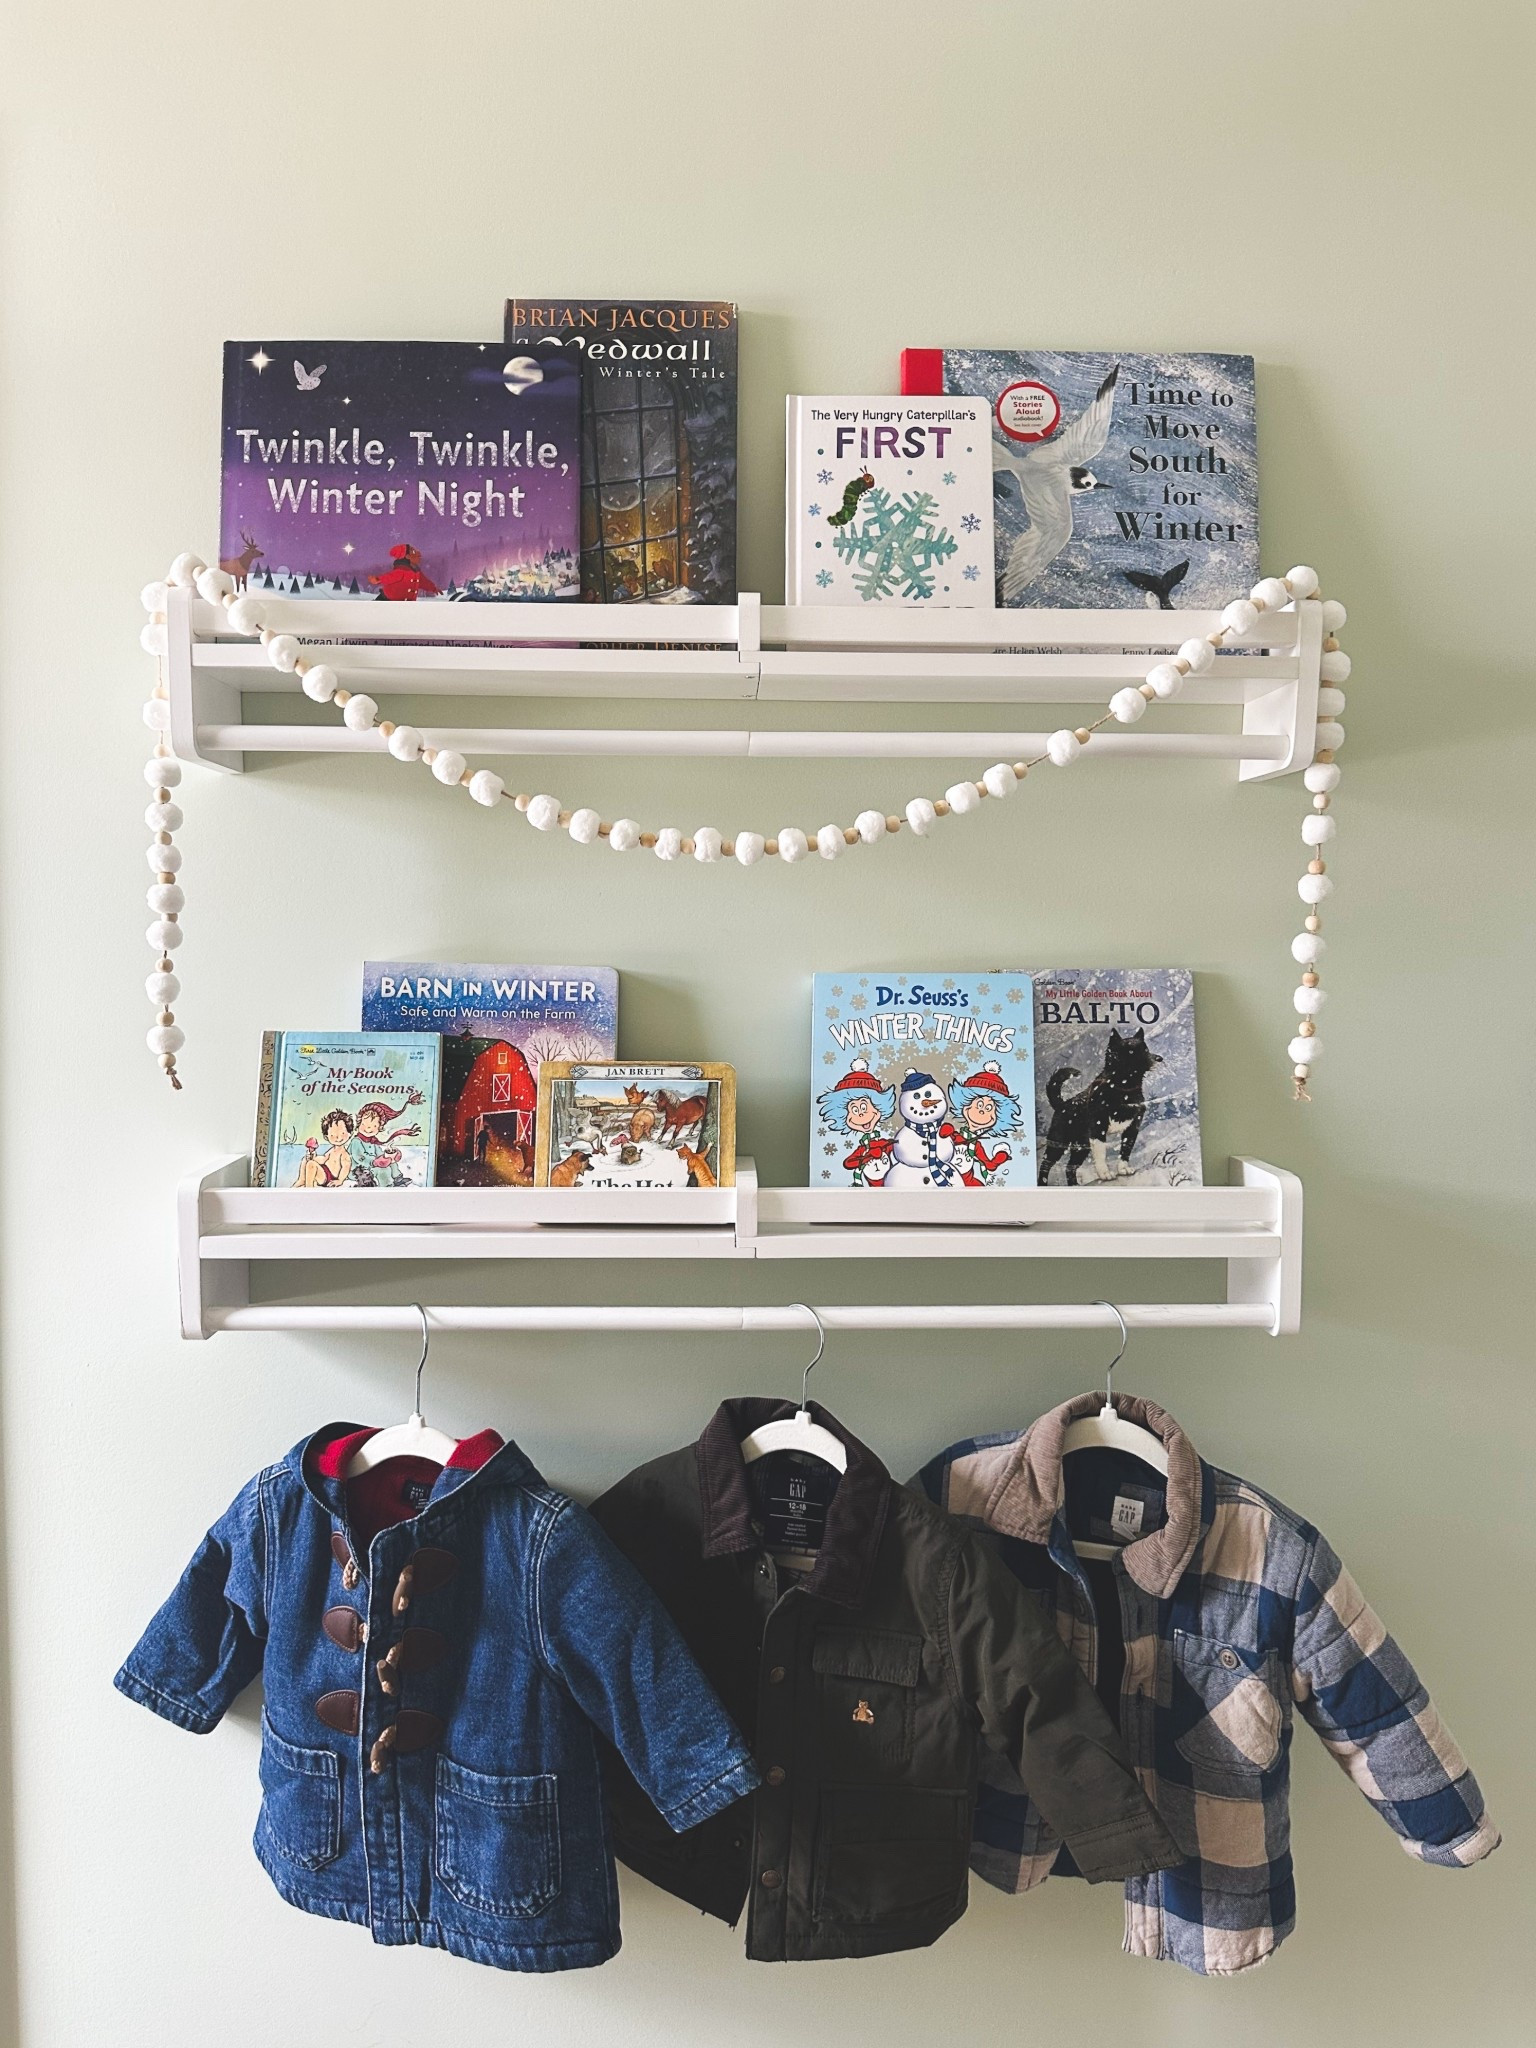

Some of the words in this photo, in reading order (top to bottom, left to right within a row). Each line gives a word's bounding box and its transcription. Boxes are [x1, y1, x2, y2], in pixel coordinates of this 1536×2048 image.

[513, 308, 598, 328] BRIAN
[606, 308, 730, 333] JACQUES
[600, 366, 678, 379] Winter's
[689, 367, 726, 379] Tale
[1124, 382, 1202, 407] Time
[1211, 386, 1234, 408] to
[811, 410, 831, 420] The
[834, 410, 859, 423] Very
[862, 410, 903, 423] Hungry
[906, 409, 976, 423] Caterpillar's
[1145, 413, 1220, 440] Move
[236, 427, 396, 472] Twinkle,
[410, 429, 570, 476] Twinkle,
[836, 426, 952, 459] FIRST
[1128, 445, 1229, 475] South
[267, 477, 404, 517] Winter
[417, 481, 526, 528] Night
[1163, 482, 1201, 507] for
[1114, 510, 1243, 543] Winter
[381, 977, 453, 998] BARN
[463, 981, 482, 996] IN
[492, 979, 596, 1001] WINTER
[875, 986, 905, 1006] Dr.
[908, 985, 969, 1007] Seuss's
[1045, 990, 1057, 999] My
[1059, 989, 1079, 998] Little
[1081, 989, 1107, 998] Golden
[1109, 990, 1128, 998] Book
[1129, 990, 1153, 998] About
[400, 1005, 428, 1017] Safe
[433, 1006, 456, 1017] and
[461, 1007, 497, 1018] Warm
[502, 1010, 516, 1018] on
[521, 1008, 540, 1018] the
[545, 1009, 576, 1019] Farm
[1040, 1002, 1160, 1024] BALTO
[829, 1013, 925, 1050] WINTER
[934, 1012, 1016, 1054] THINGS
[326, 1067, 353, 1081] My
[354, 1067, 394, 1079] Book
[605, 1068, 626, 1077] JAN
[301, 1081, 321, 1096] of
[321, 1081, 346, 1093] the
[348, 1082, 415, 1095] Seasons
[873, 1162, 881, 1172] 1
[955, 1157, 964, 1168] 2
[789, 1483, 806, 1498] GAP
[1119, 1509, 1136, 1524] GAP
